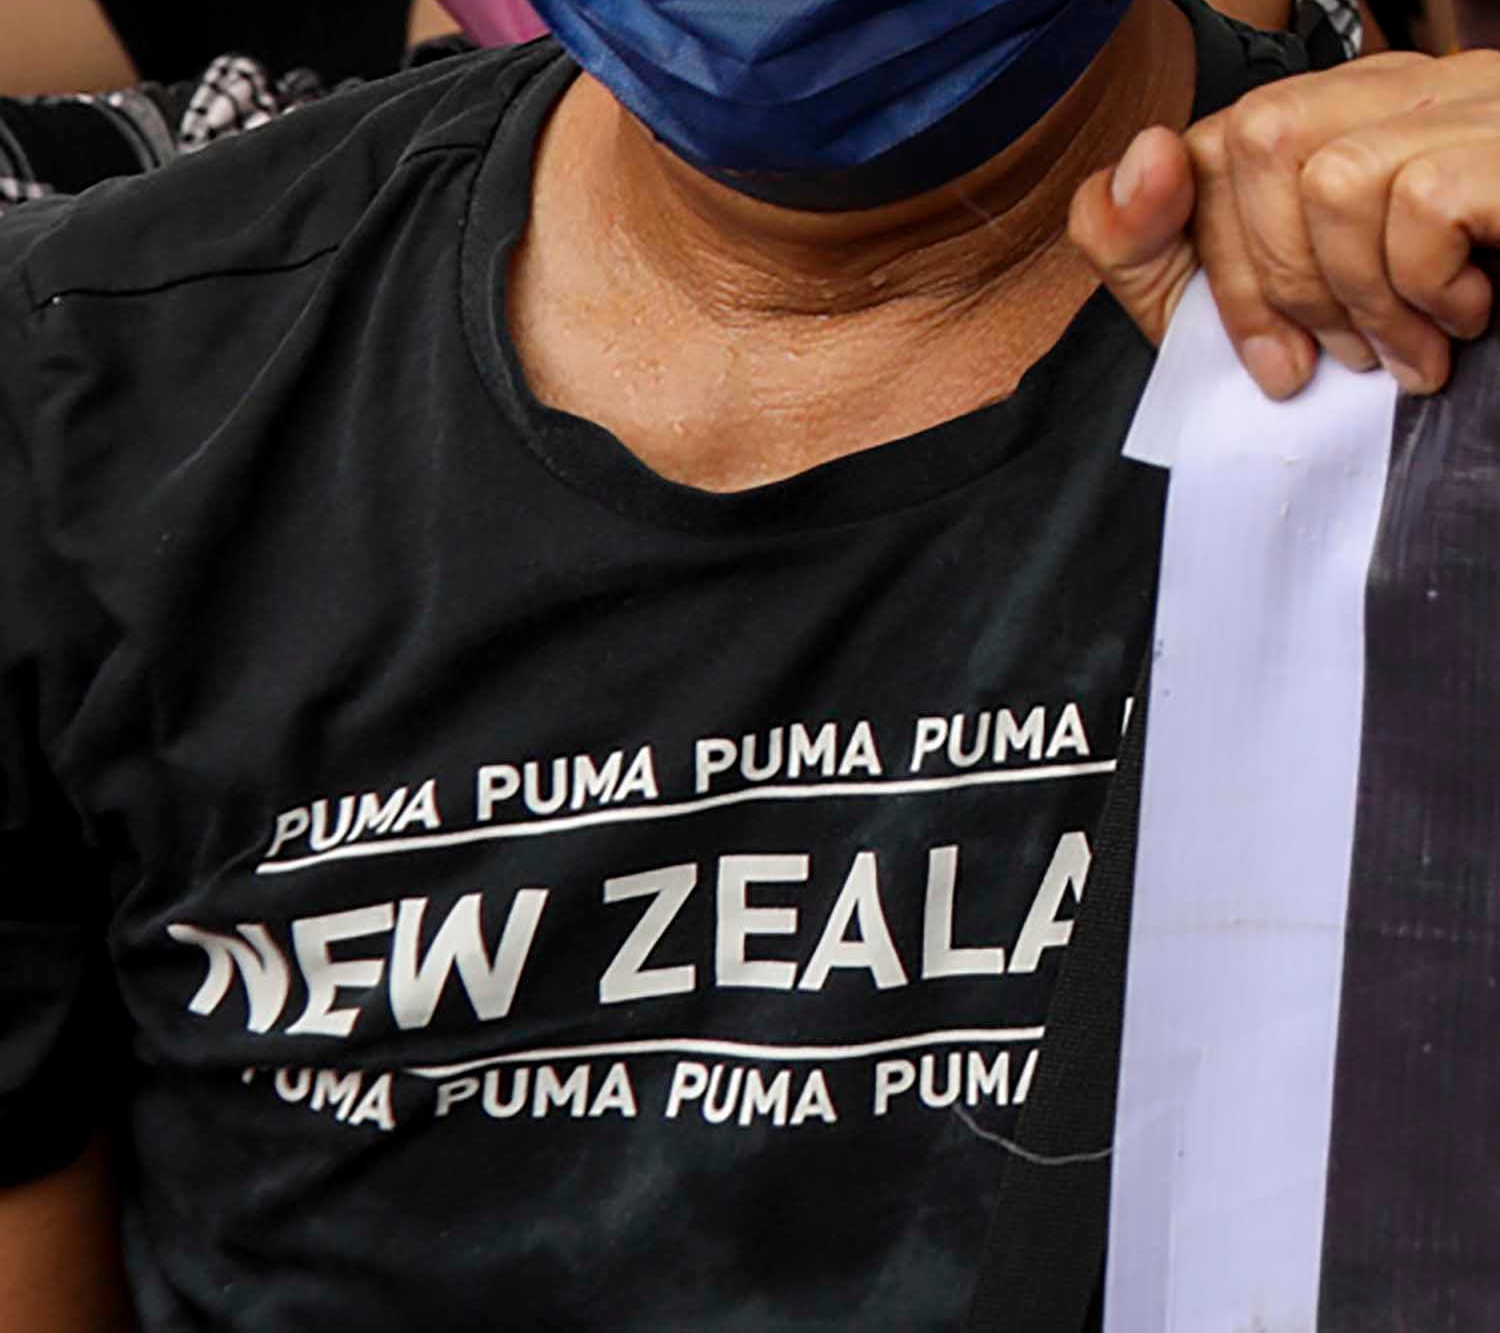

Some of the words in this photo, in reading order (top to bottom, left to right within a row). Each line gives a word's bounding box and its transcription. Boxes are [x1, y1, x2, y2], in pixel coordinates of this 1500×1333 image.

[266, 778, 440, 858] PUMA
[475, 746, 659, 821] PUMA
[694, 722, 882, 794] PUMA
[910, 702, 1091, 774] PUMA
[169, 889, 549, 1037] NEW
[243, 1066, 396, 1131] UMA
[435, 1066, 638, 1120] PUMA
[664, 1061, 837, 1127] PUMA
